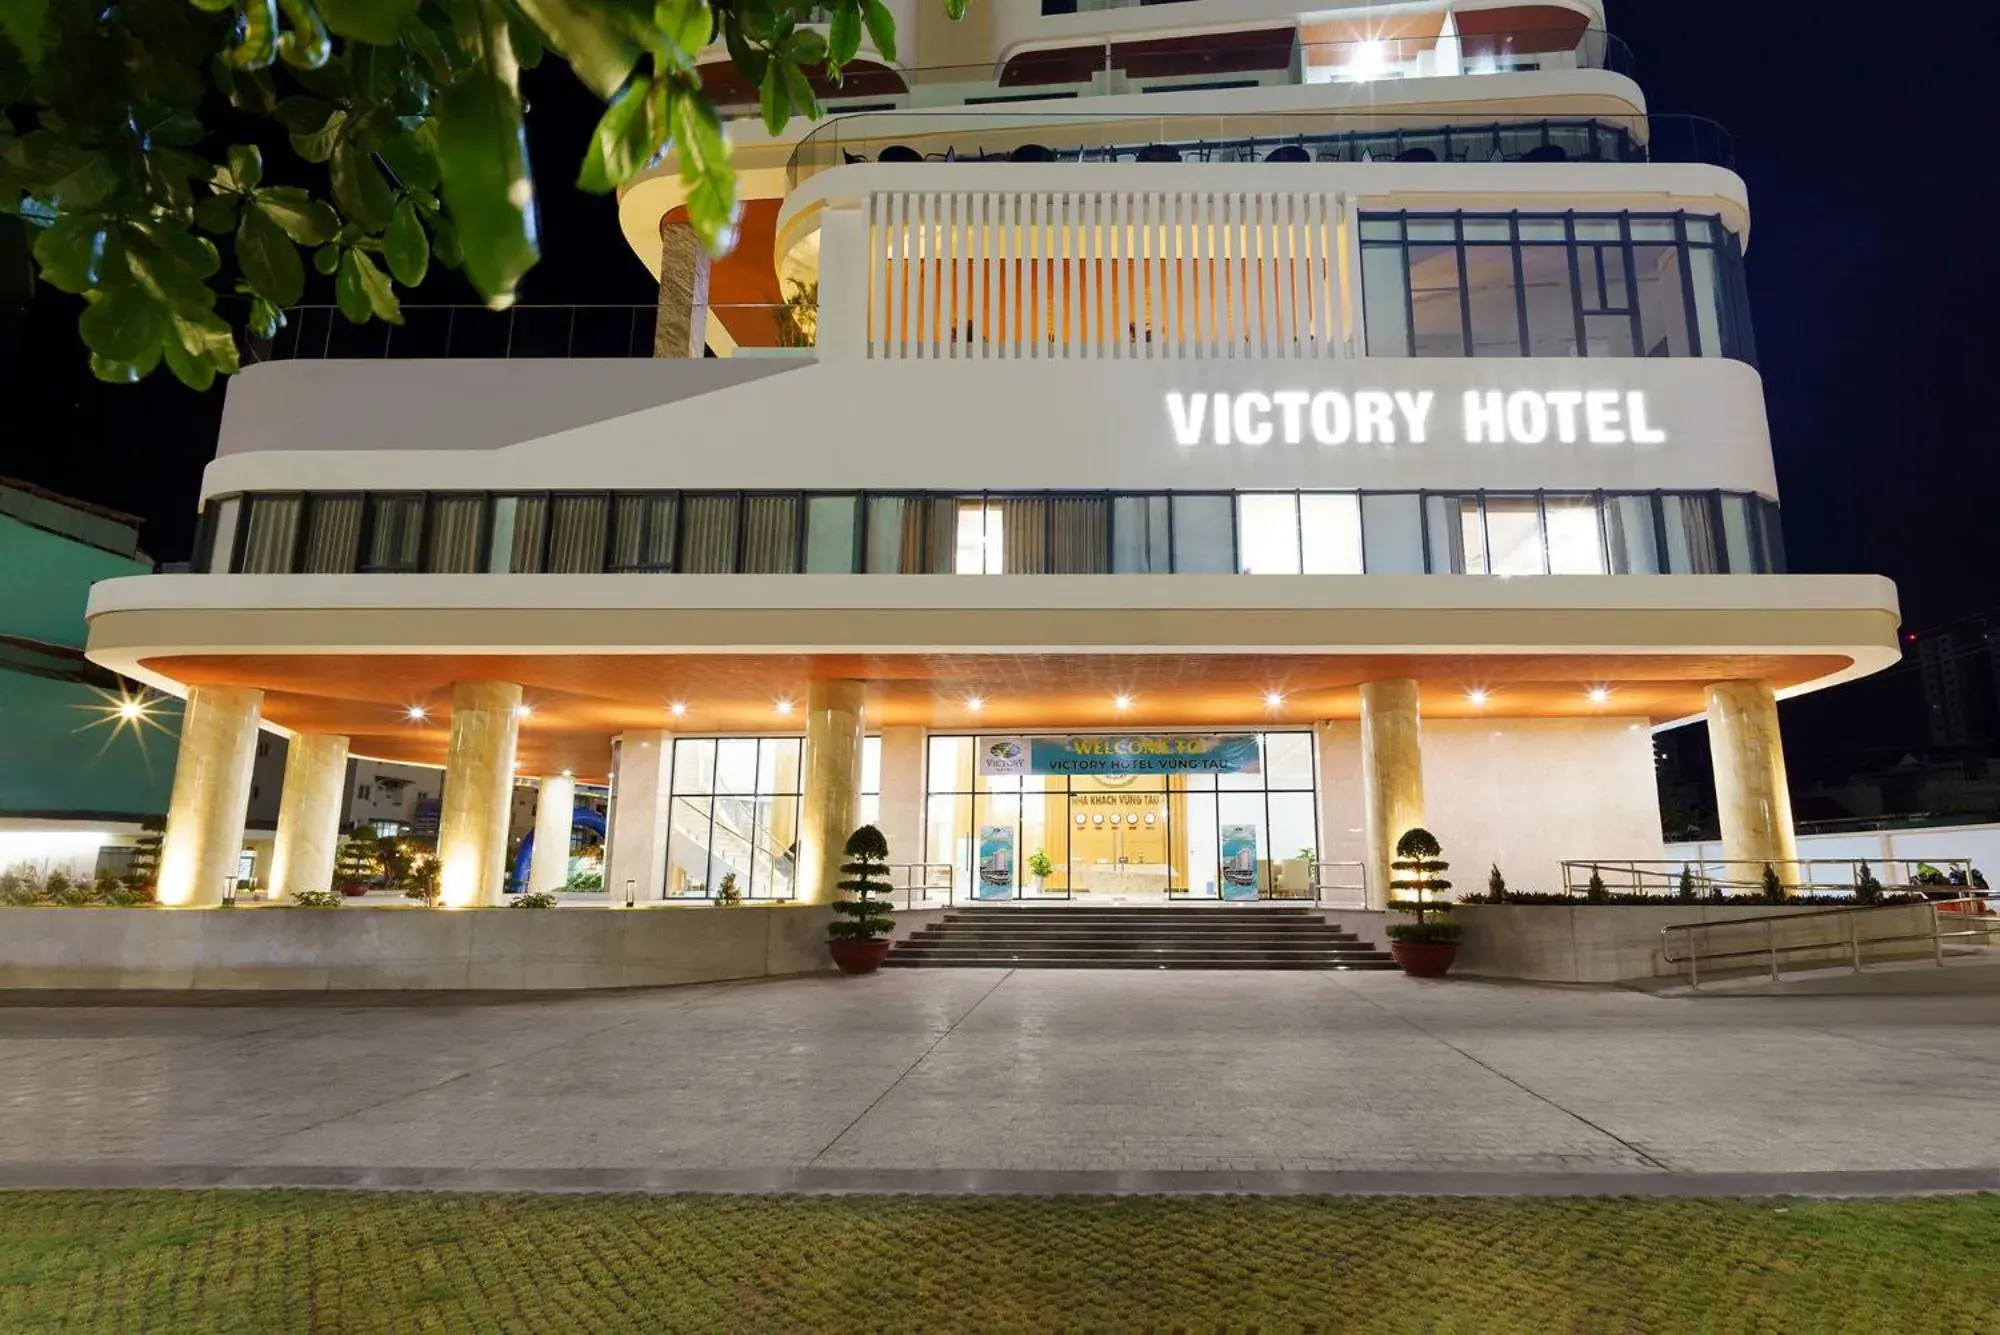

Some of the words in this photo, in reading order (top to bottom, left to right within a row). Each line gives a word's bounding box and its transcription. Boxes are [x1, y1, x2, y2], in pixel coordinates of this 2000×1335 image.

[1166, 391, 1434, 445] VICTORY
[1464, 390, 1666, 444] HOTEL
[1049, 760, 1106, 770] VICTORY
[1111, 760, 1153, 769] HOTEL
[1158, 759, 1199, 769] VUNG
[1202, 759, 1228, 769] TAU
